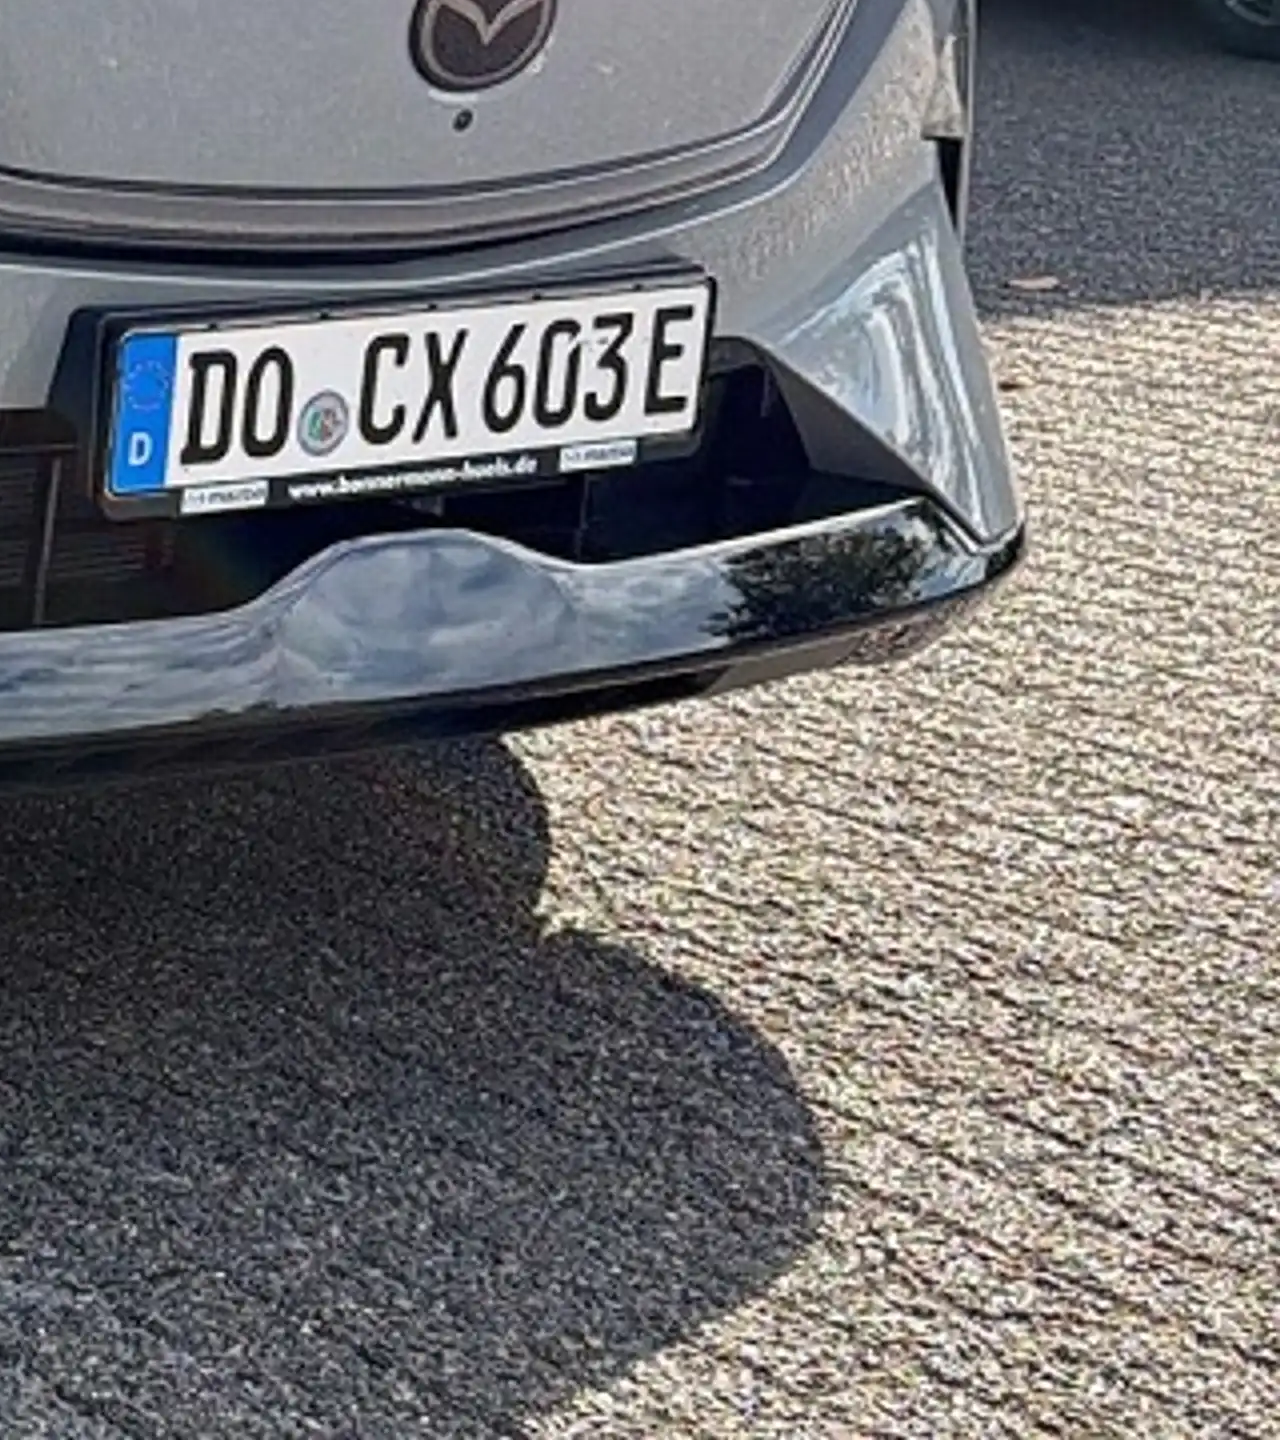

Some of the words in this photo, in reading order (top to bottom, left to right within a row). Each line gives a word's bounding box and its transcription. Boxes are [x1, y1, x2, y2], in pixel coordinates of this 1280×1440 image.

[127, 430, 152, 467] D
[180, 347, 293, 465] DO
[358, 329, 468, 445] CX
